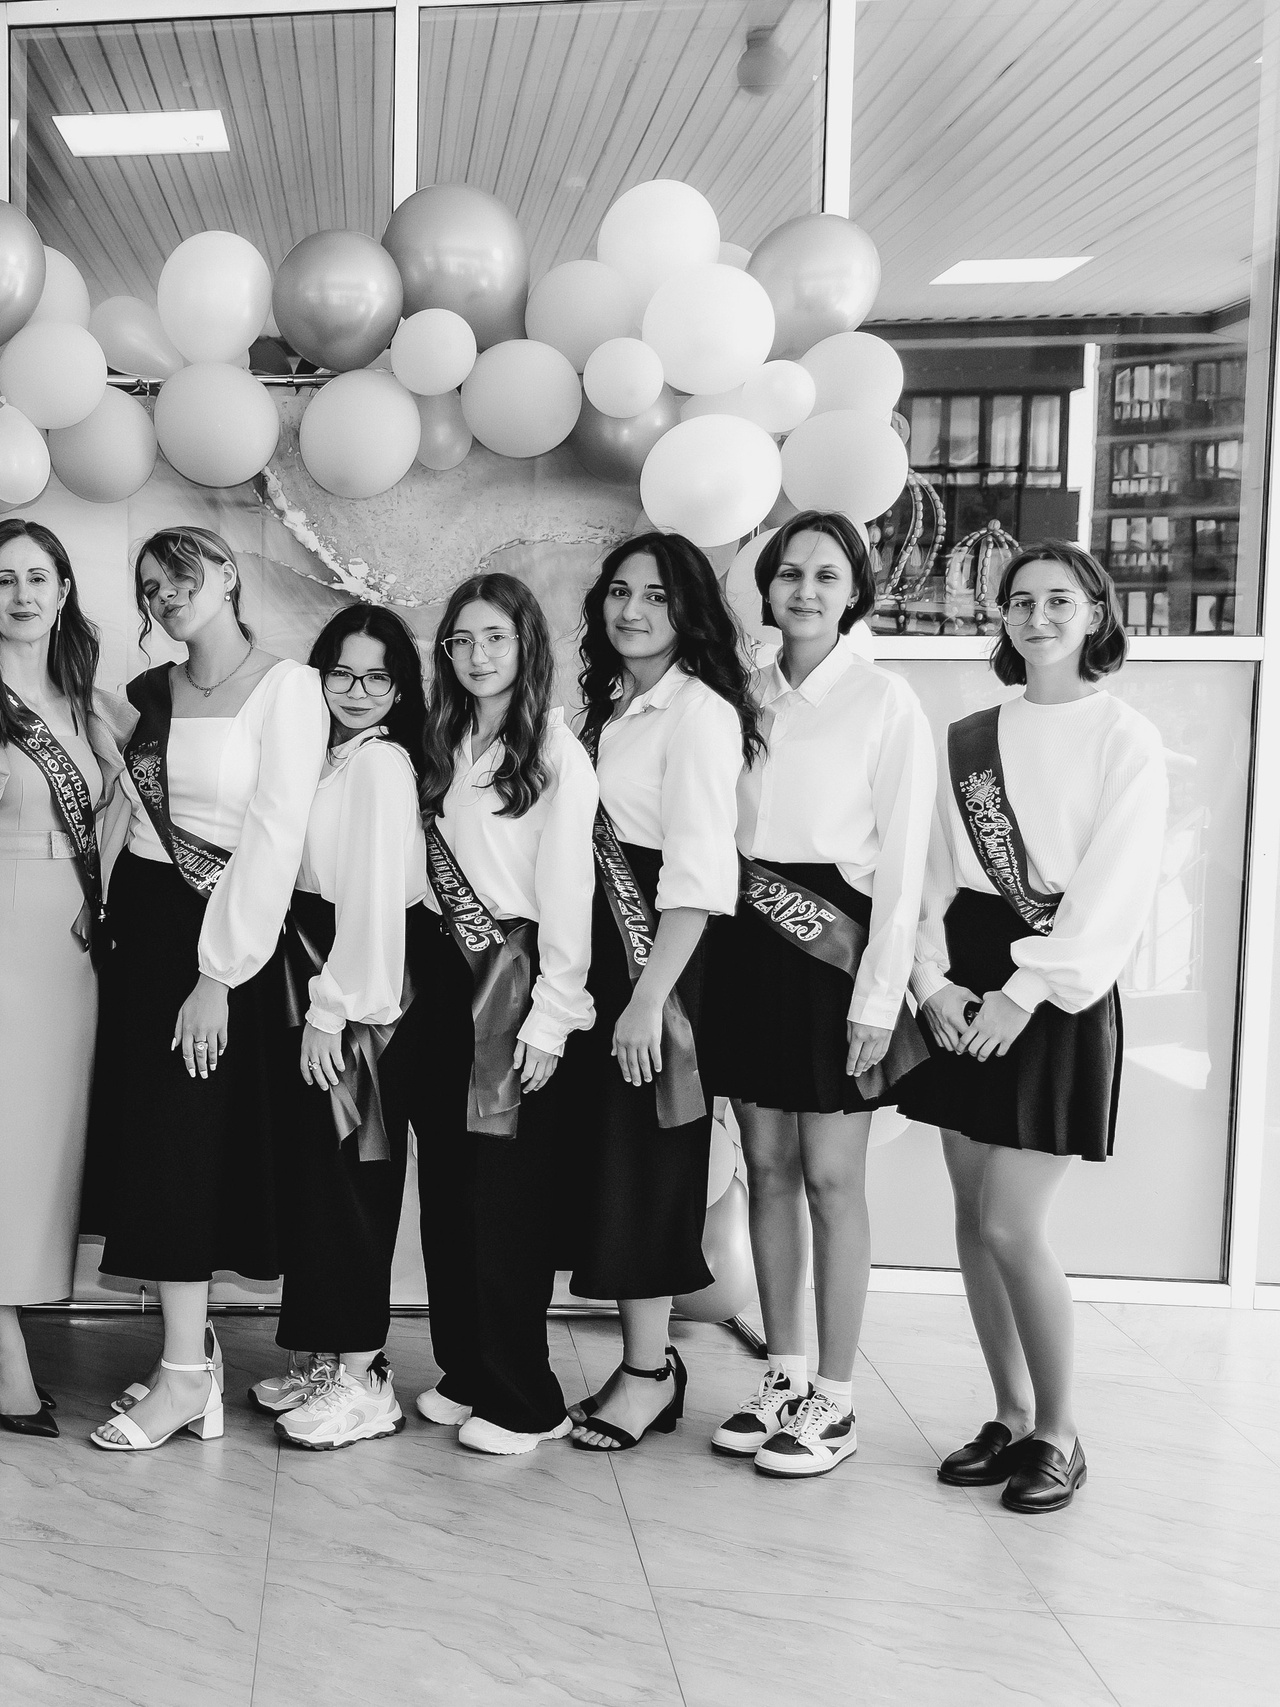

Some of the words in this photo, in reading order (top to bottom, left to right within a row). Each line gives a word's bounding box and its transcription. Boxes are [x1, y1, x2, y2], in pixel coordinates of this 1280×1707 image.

[25, 737, 88, 849] ОВОДИТЕЛЬ
[31, 719, 91, 809] Классный
[441, 886, 505, 952] 2025
[753, 882, 837, 942] 2025
